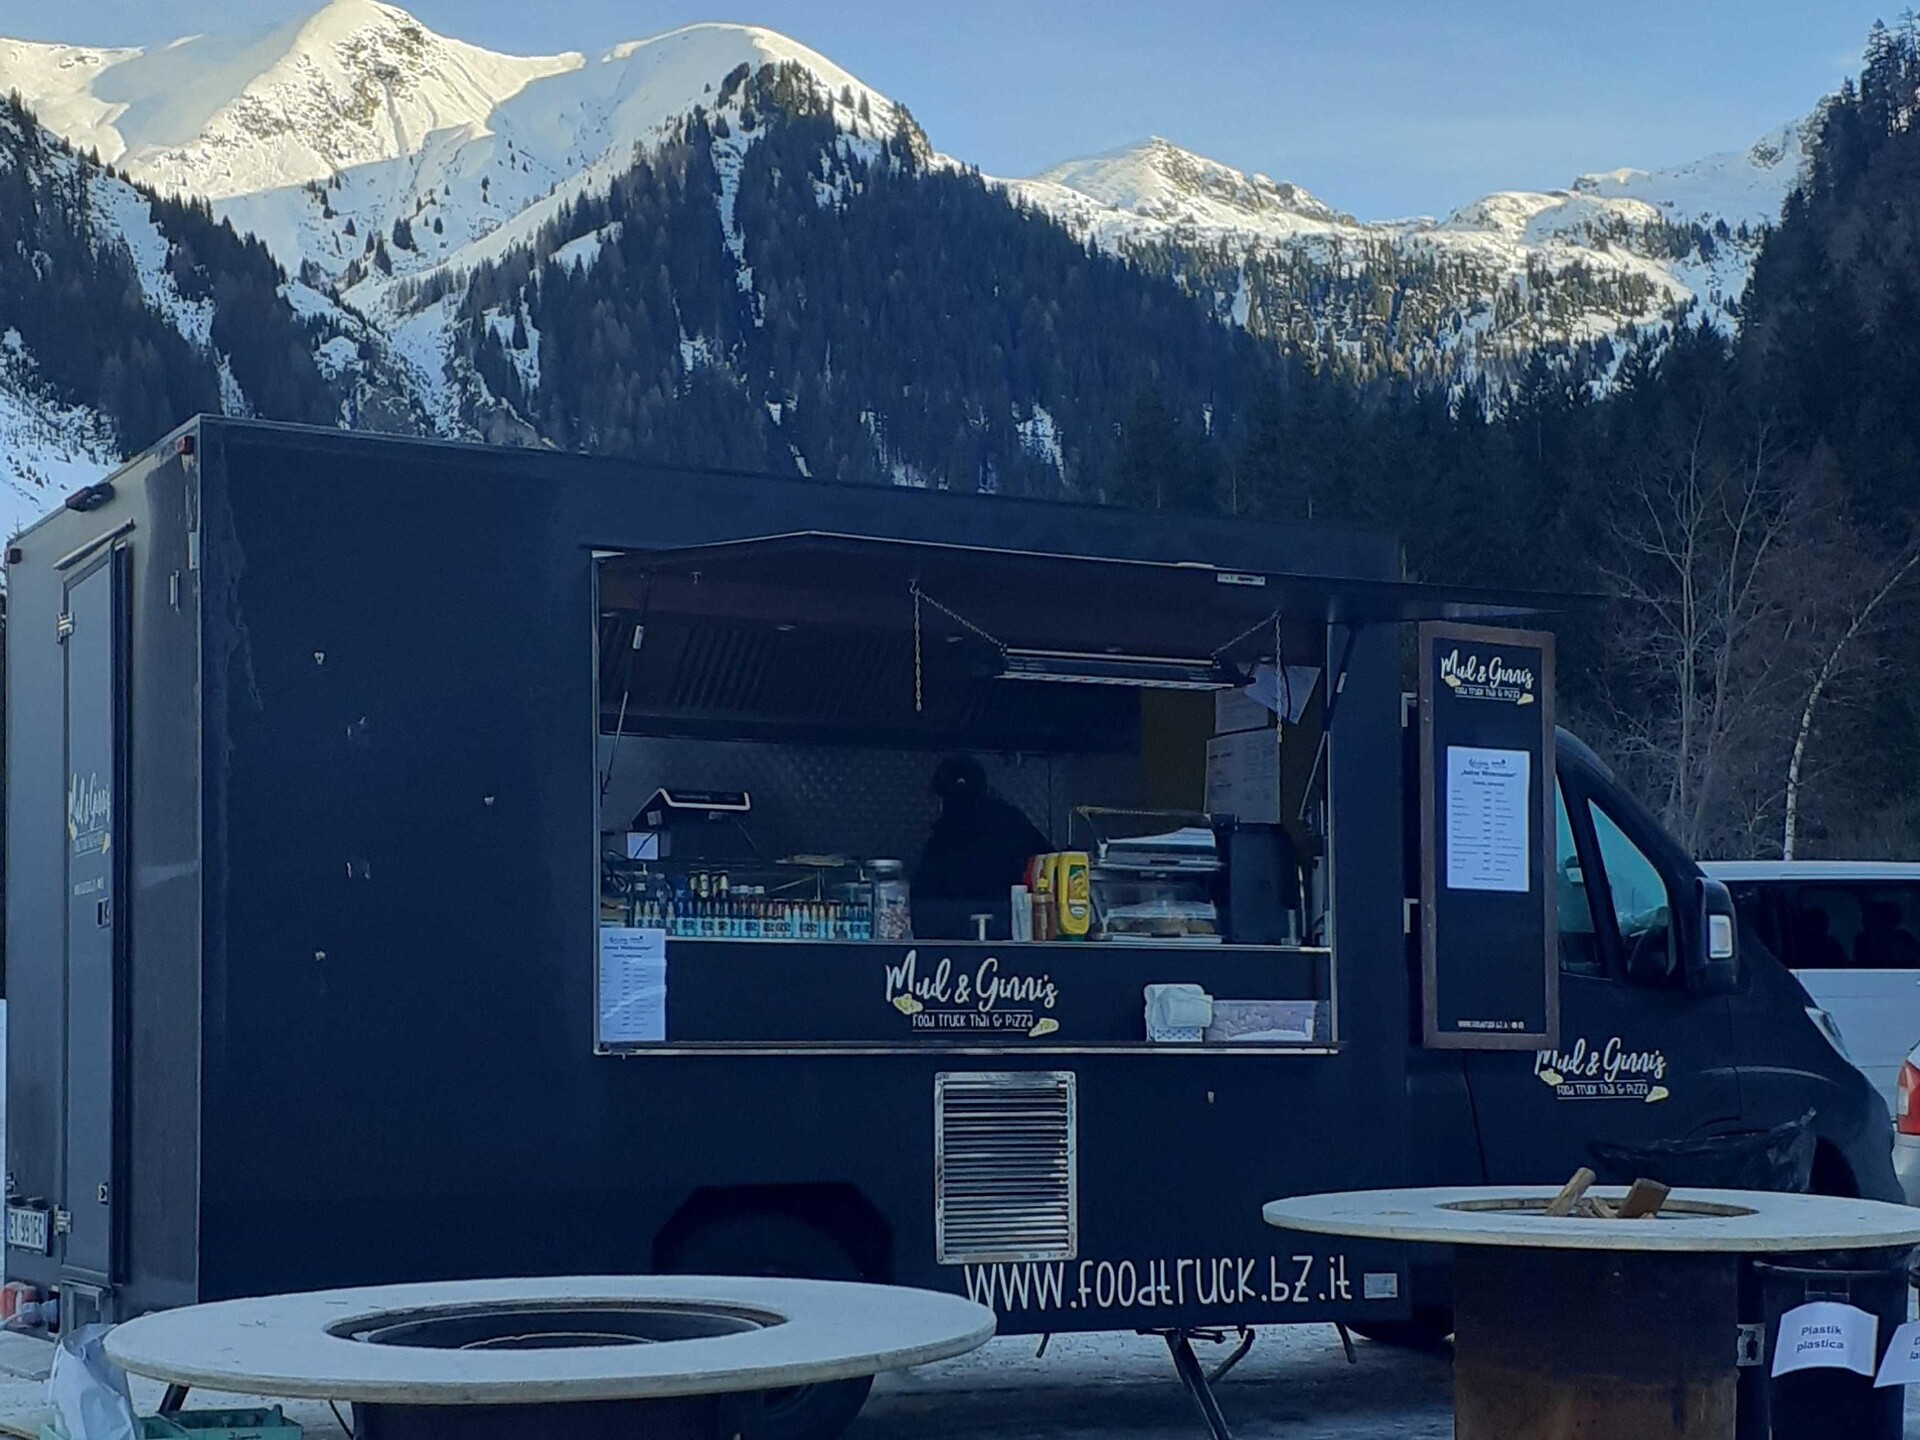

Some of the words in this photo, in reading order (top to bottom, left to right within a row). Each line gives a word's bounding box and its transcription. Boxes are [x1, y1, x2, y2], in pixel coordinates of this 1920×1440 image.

[1477, 665, 1487, 682] &
[954, 974, 971, 1003] &
[1586, 1051, 1600, 1076] &
[1801, 1325, 1842, 1336] Plastik
[1796, 1339, 1844, 1353] plastica
